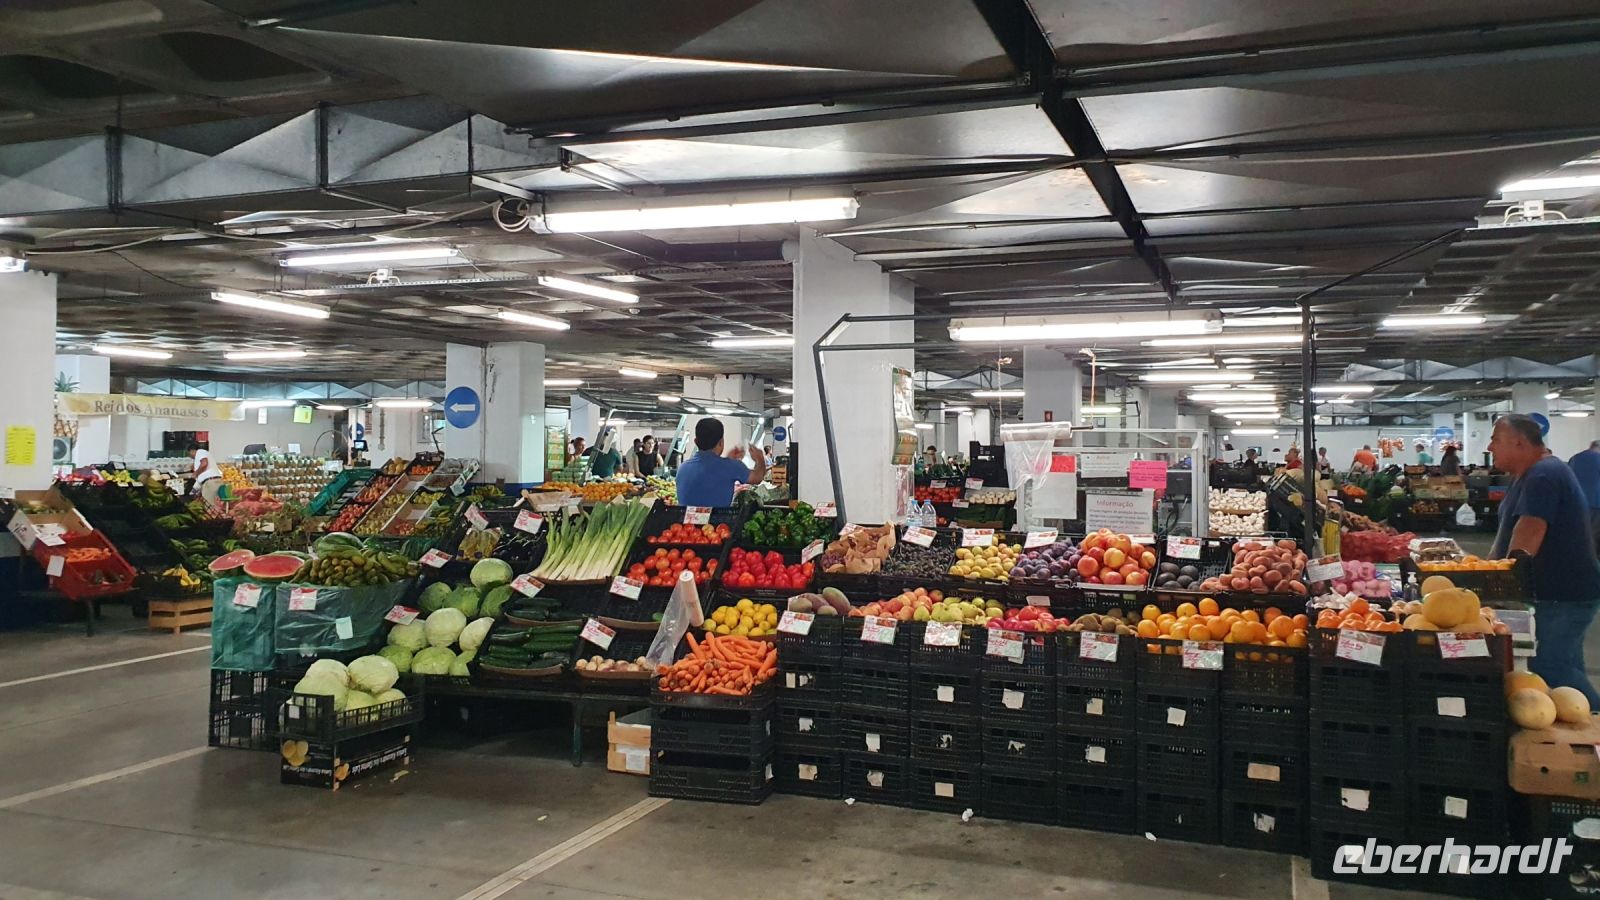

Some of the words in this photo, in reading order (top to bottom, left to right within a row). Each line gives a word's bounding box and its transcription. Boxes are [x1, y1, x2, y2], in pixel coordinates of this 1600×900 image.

[94, 400, 114, 413] Rei
[115, 401, 141, 414] dos
[144, 404, 209, 418] Ananases
